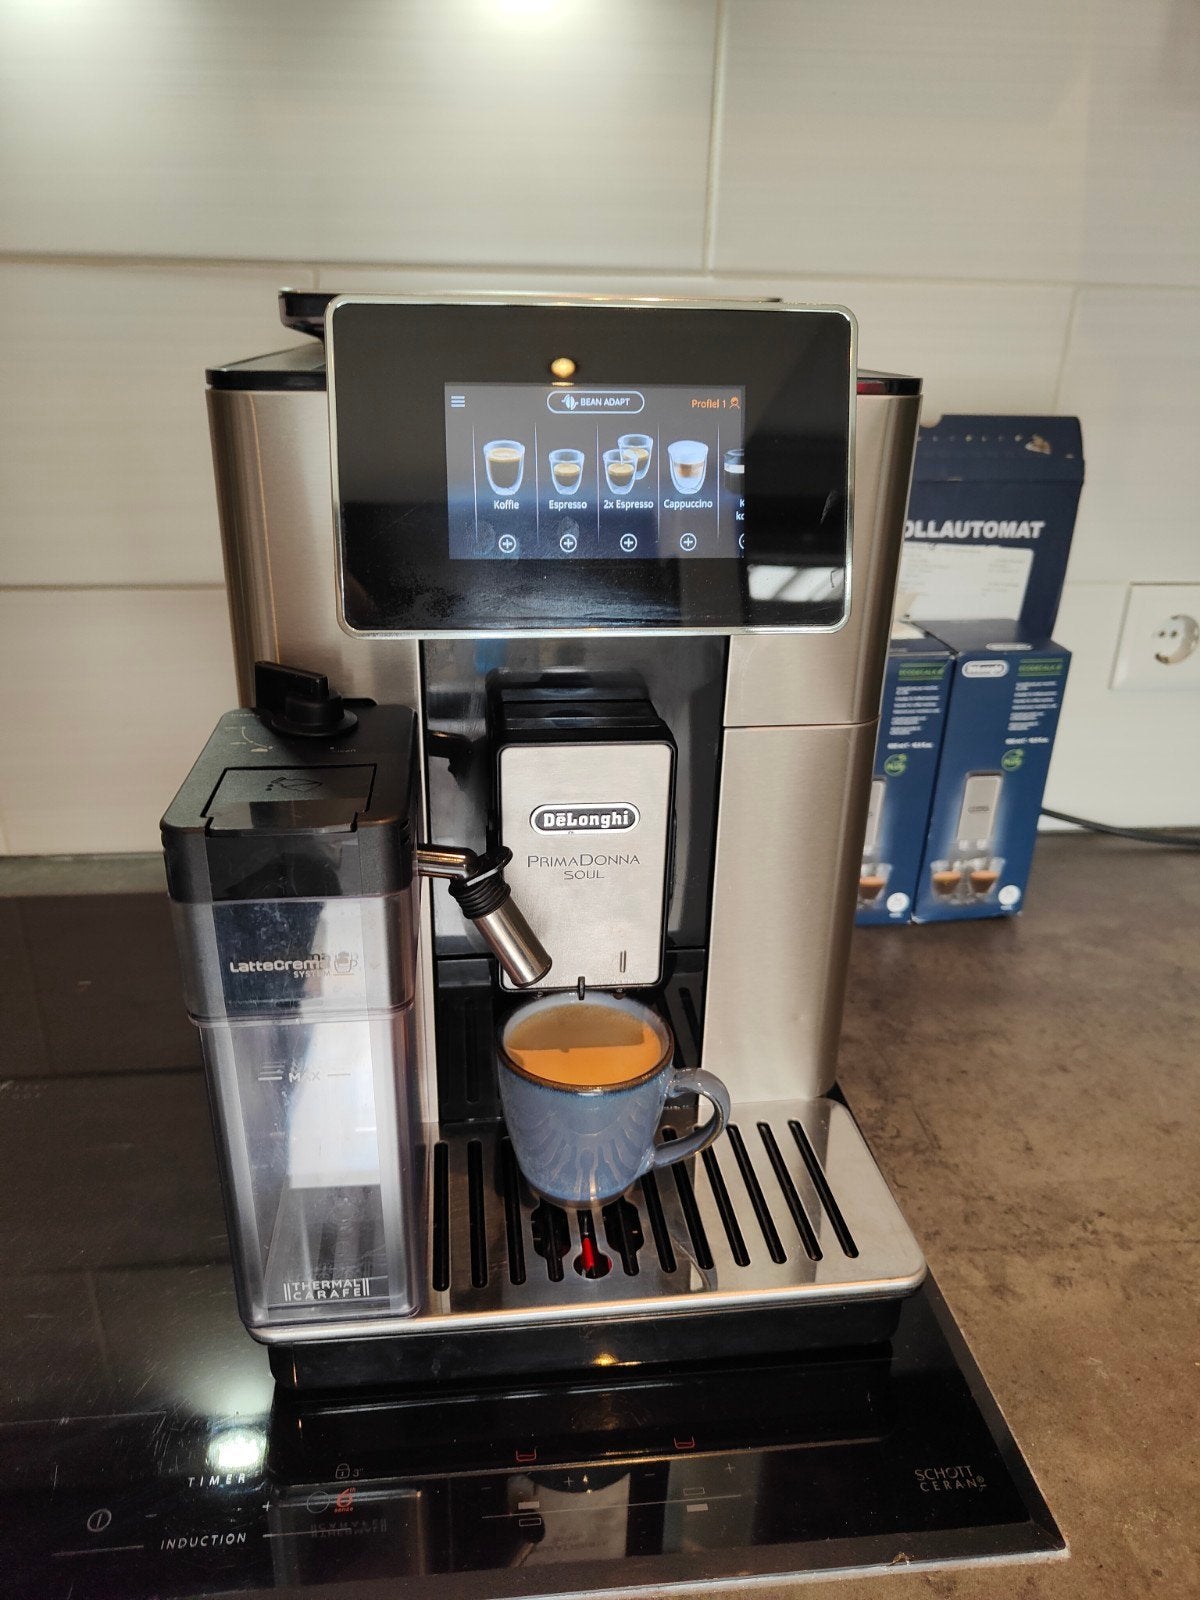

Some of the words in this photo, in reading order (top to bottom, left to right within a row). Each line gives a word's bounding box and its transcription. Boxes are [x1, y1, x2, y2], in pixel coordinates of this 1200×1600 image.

[580, 397, 602, 407] BEAN
[603, 397, 632, 407] ADAPT
[691, 398, 720, 409] Profiel
[722, 399, 727, 409] 1
[493, 499, 520, 510] Koffie
[548, 499, 588, 510] Espresso
[603, 499, 615, 509] 2x
[616, 499, 654, 510] Espresso
[663, 498, 713, 510] Cappuccino
[563, 869, 605, 881] SOUL
[288, 1071, 321, 1083] MAX
[292, 1278, 361, 1292] THERMAL
[293, 1287, 362, 1301] CARAFE
[914, 1465, 973, 1481] SCHOTT
[187, 1472, 246, 1488] TIMER
[160, 1532, 247, 1551] INDUCTION
